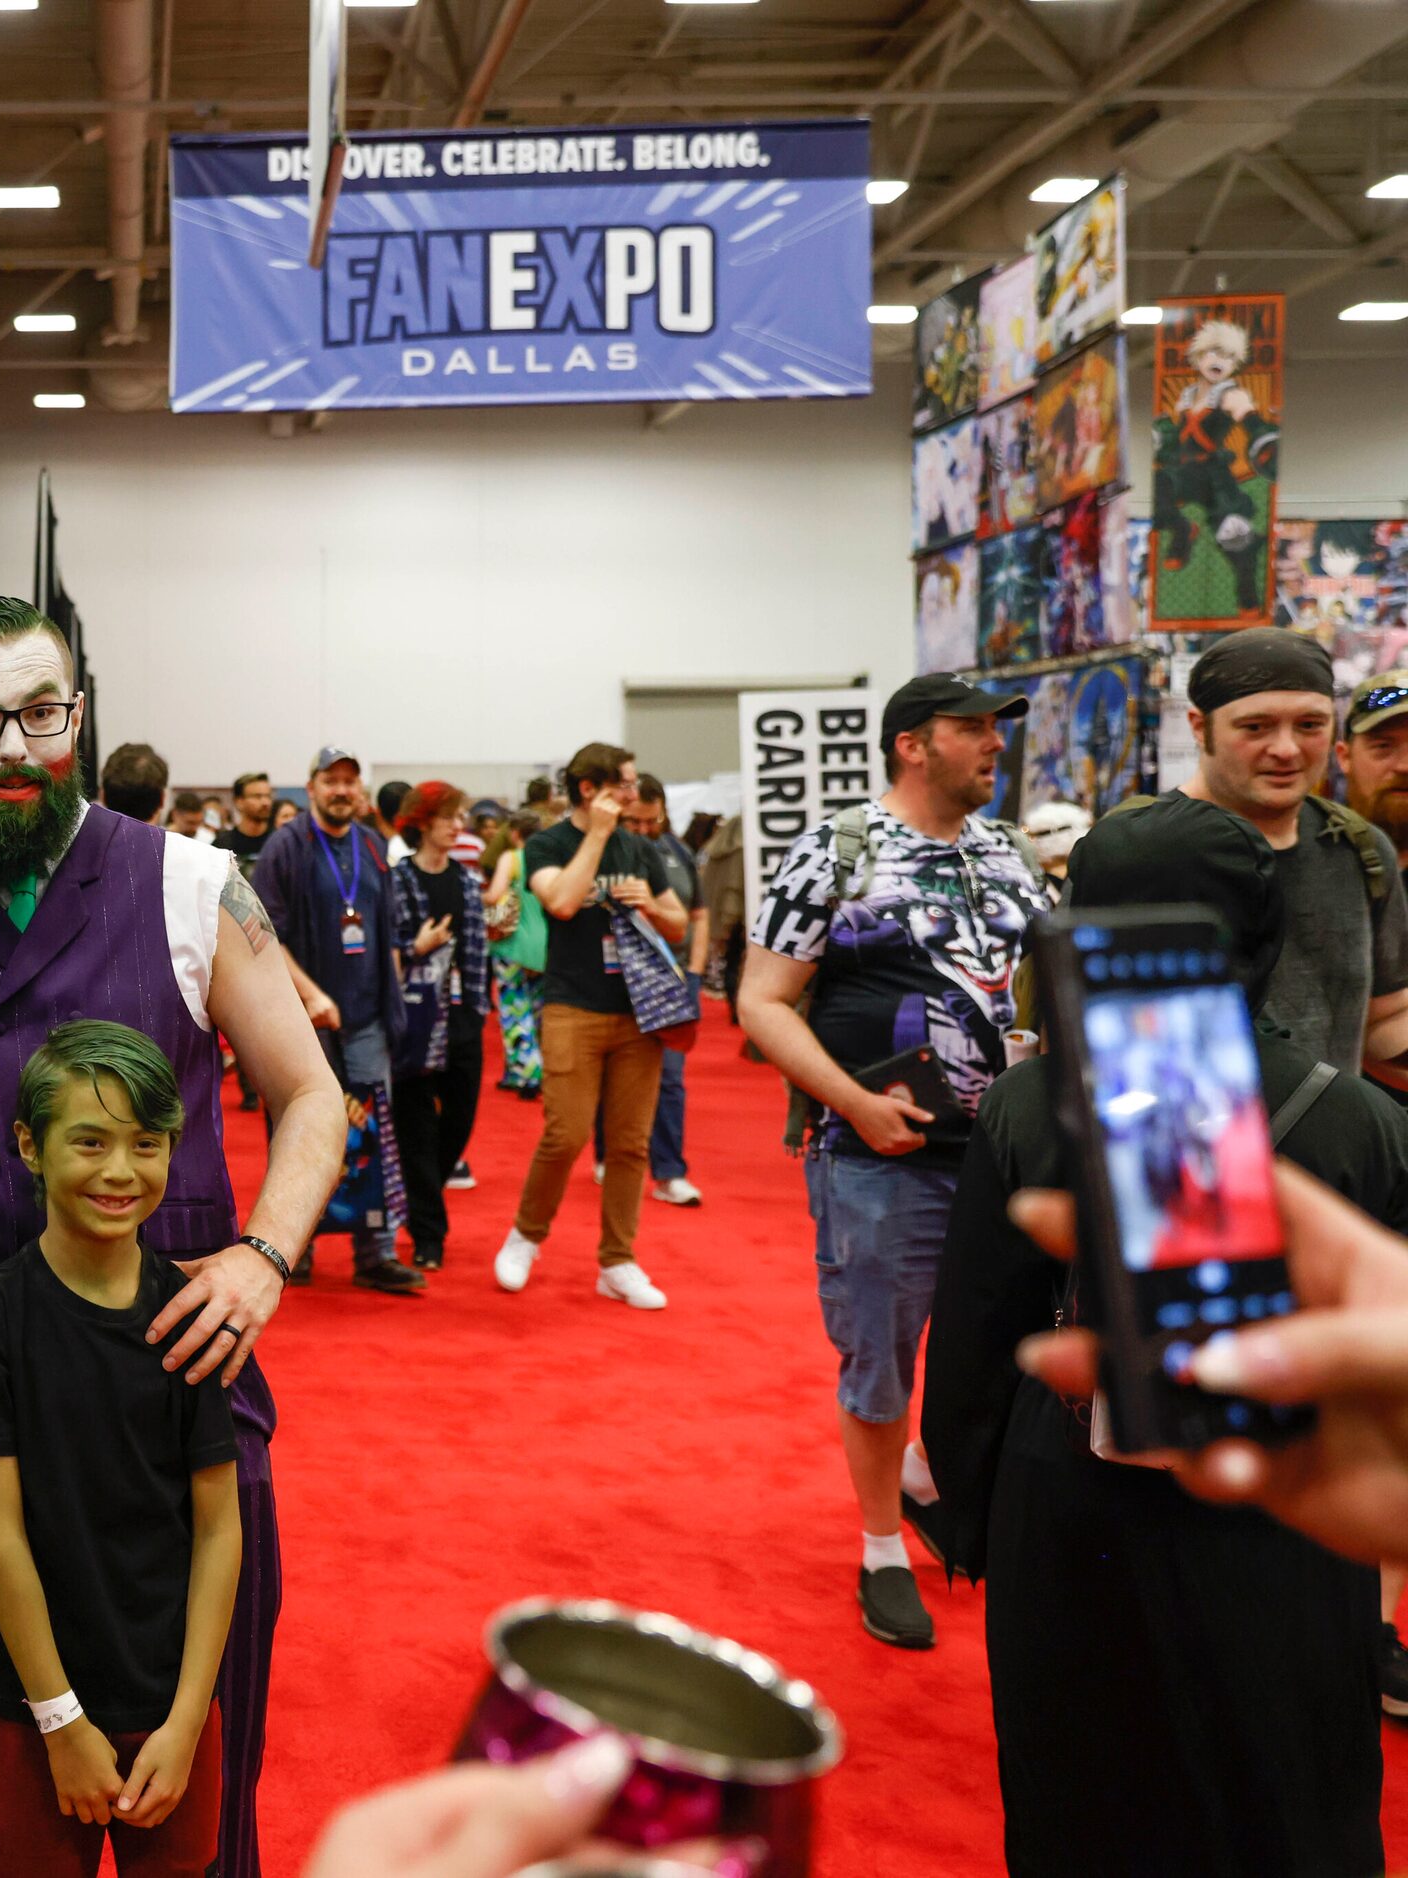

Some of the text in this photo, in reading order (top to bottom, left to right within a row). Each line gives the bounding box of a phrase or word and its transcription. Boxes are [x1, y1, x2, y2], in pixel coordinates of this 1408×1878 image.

[267, 132, 772, 182] DIOVER. CELEBRATE. BELONG.
[401, 342, 638, 377] DALLAS
[756, 709, 806, 898] GARDE
